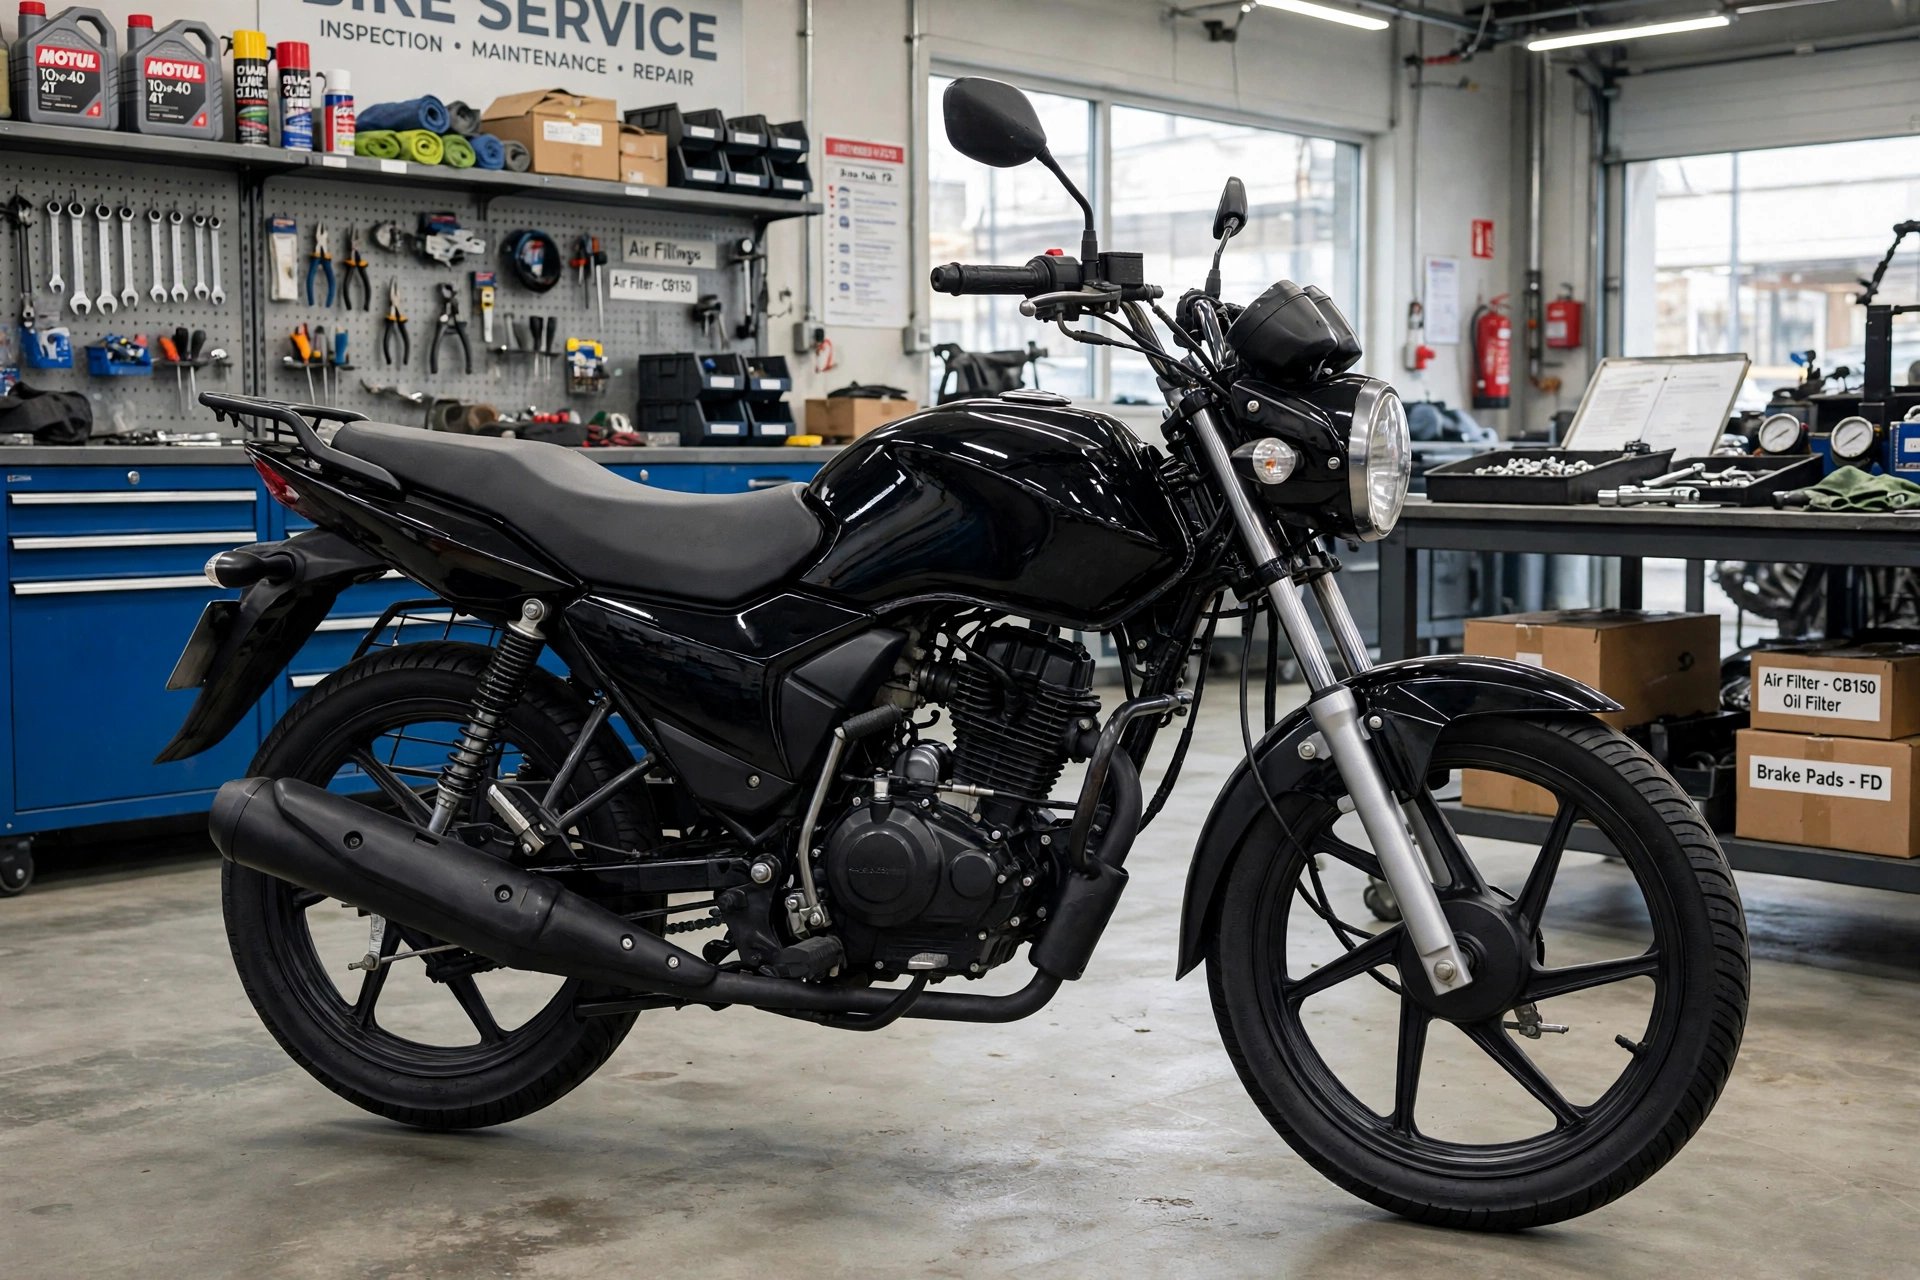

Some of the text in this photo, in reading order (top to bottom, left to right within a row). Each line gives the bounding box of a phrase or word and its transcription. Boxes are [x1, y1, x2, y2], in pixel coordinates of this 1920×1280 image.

[478, 0, 717, 61] SERVICE
[38, 48, 96, 69] MOTUL
[320, 19, 442, 52] INSPECTION
[472, 40, 607, 74] MAINTENANCE
[633, 63, 694, 86] REPAIR
[147, 60, 202, 79] MOTUL
[41, 80, 57, 93] 4T
[149, 91, 164, 104] 4T
[628, 240, 649, 257] Air
[1763, 673, 1783, 687] Air
[1786, 674, 1820, 691] Filter
[1832, 678, 1876, 694] CB150
[1783, 694, 1841, 712] Oil Filter
[1757, 764, 1801, 783] Brake
[1806, 768, 1844, 787] Pads
[1860, 774, 1882, 790] FD
